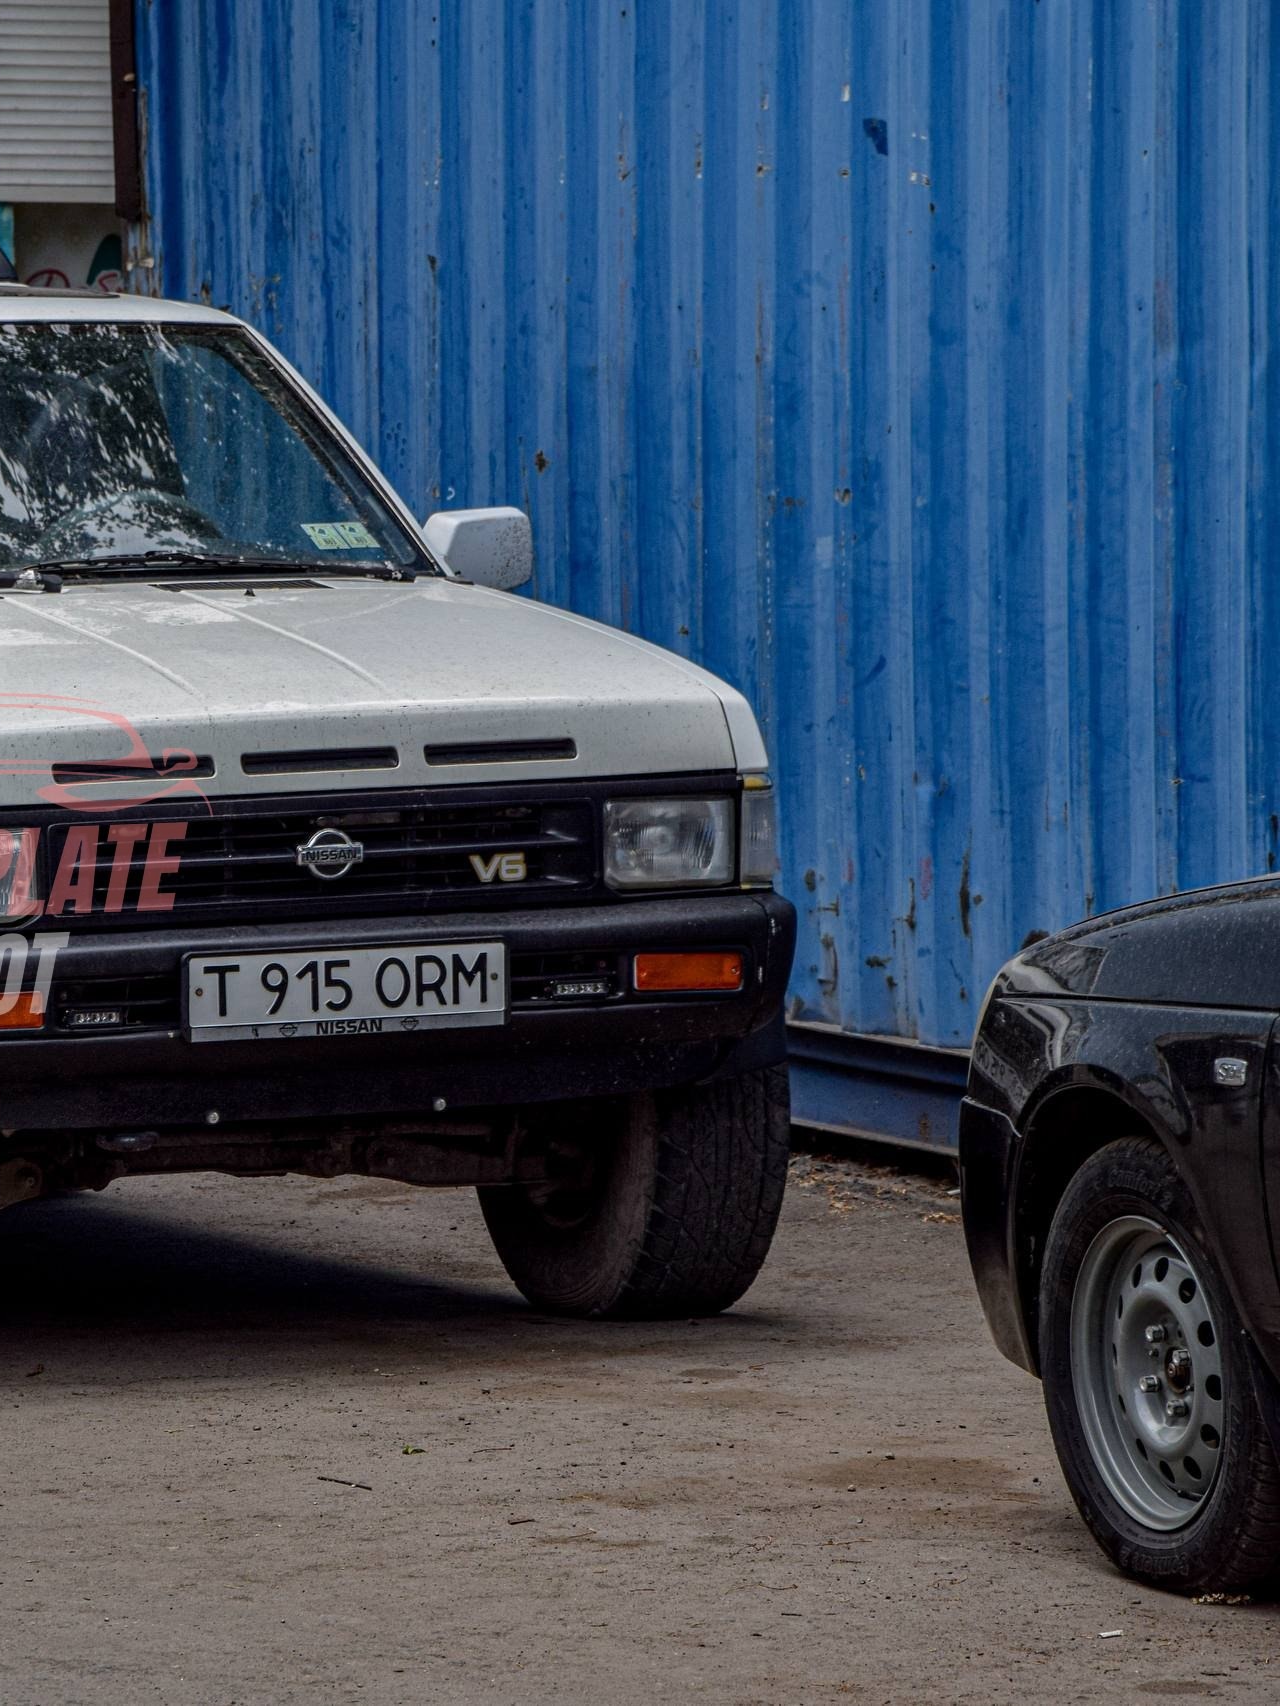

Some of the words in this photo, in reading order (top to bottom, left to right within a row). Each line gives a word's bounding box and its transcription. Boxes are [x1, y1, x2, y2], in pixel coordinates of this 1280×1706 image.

[304, 849, 357, 862] NISSAN
[468, 852, 527, 882] V6
[203, 964, 240, 1017] T
[261, 960, 353, 1017] 915
[375, 952, 488, 1008] ORM
[316, 1019, 383, 1036] NISSAN
